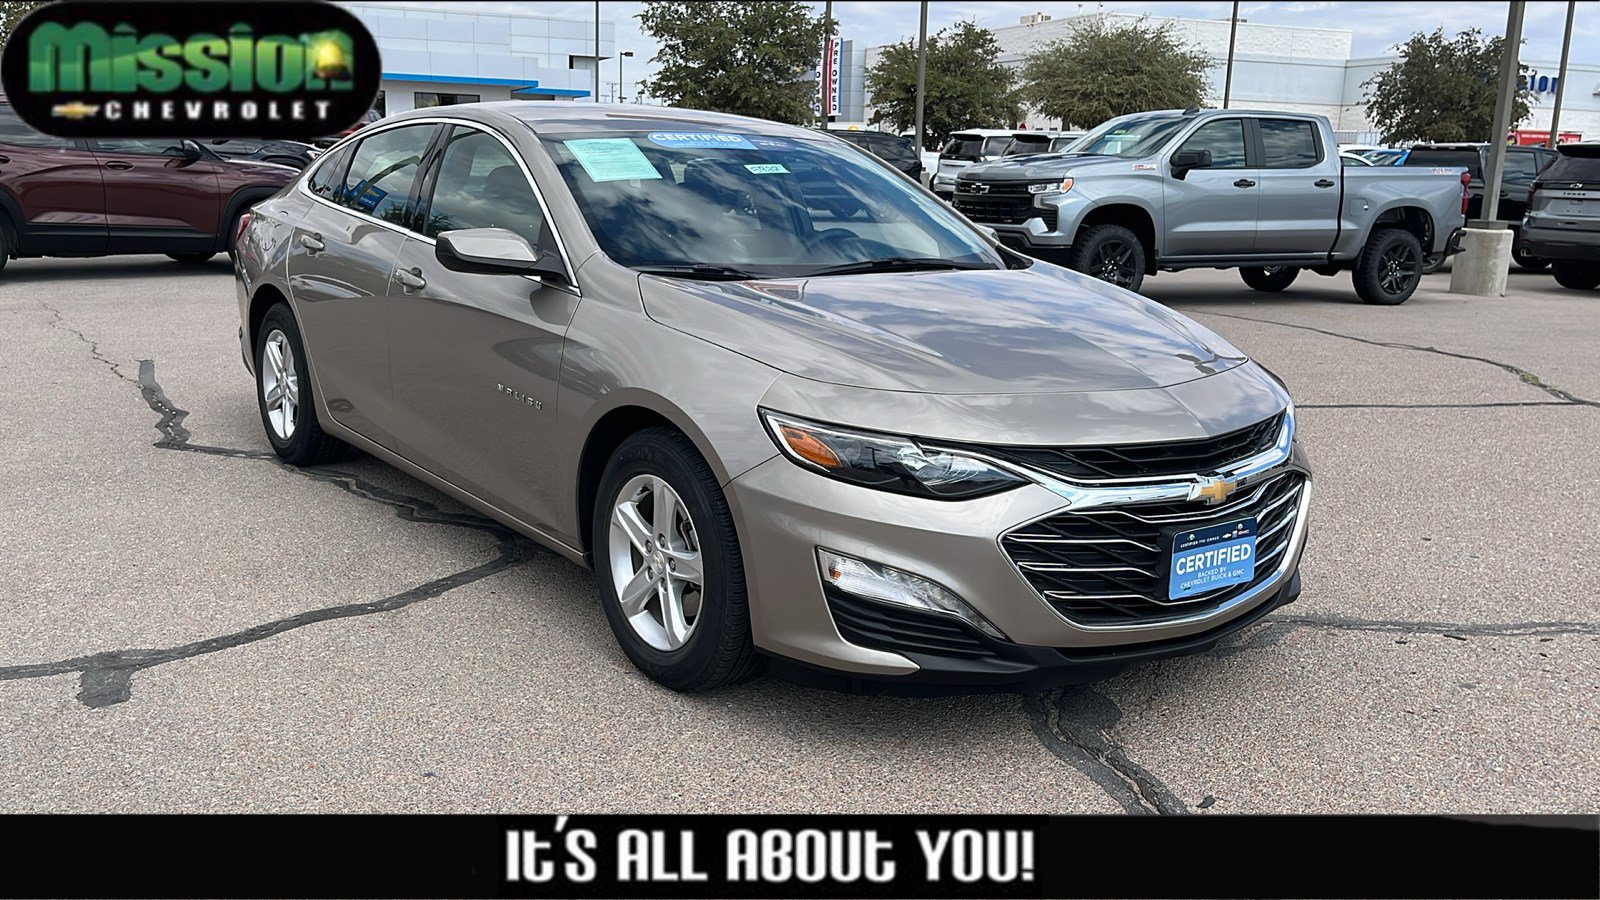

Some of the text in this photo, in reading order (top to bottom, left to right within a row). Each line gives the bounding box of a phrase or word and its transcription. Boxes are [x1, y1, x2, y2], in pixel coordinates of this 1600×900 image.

[652, 133, 741, 142] CERTIFIED
[498, 383, 542, 410] MALIBU
[1176, 543, 1252, 575] CERTIFIED
[1180, 577, 1210, 589] CHEVROLET
[1211, 573, 1227, 582] BUICK
[1233, 568, 1244, 576] GMC
[1198, 566, 1226, 578] BACKED BY
